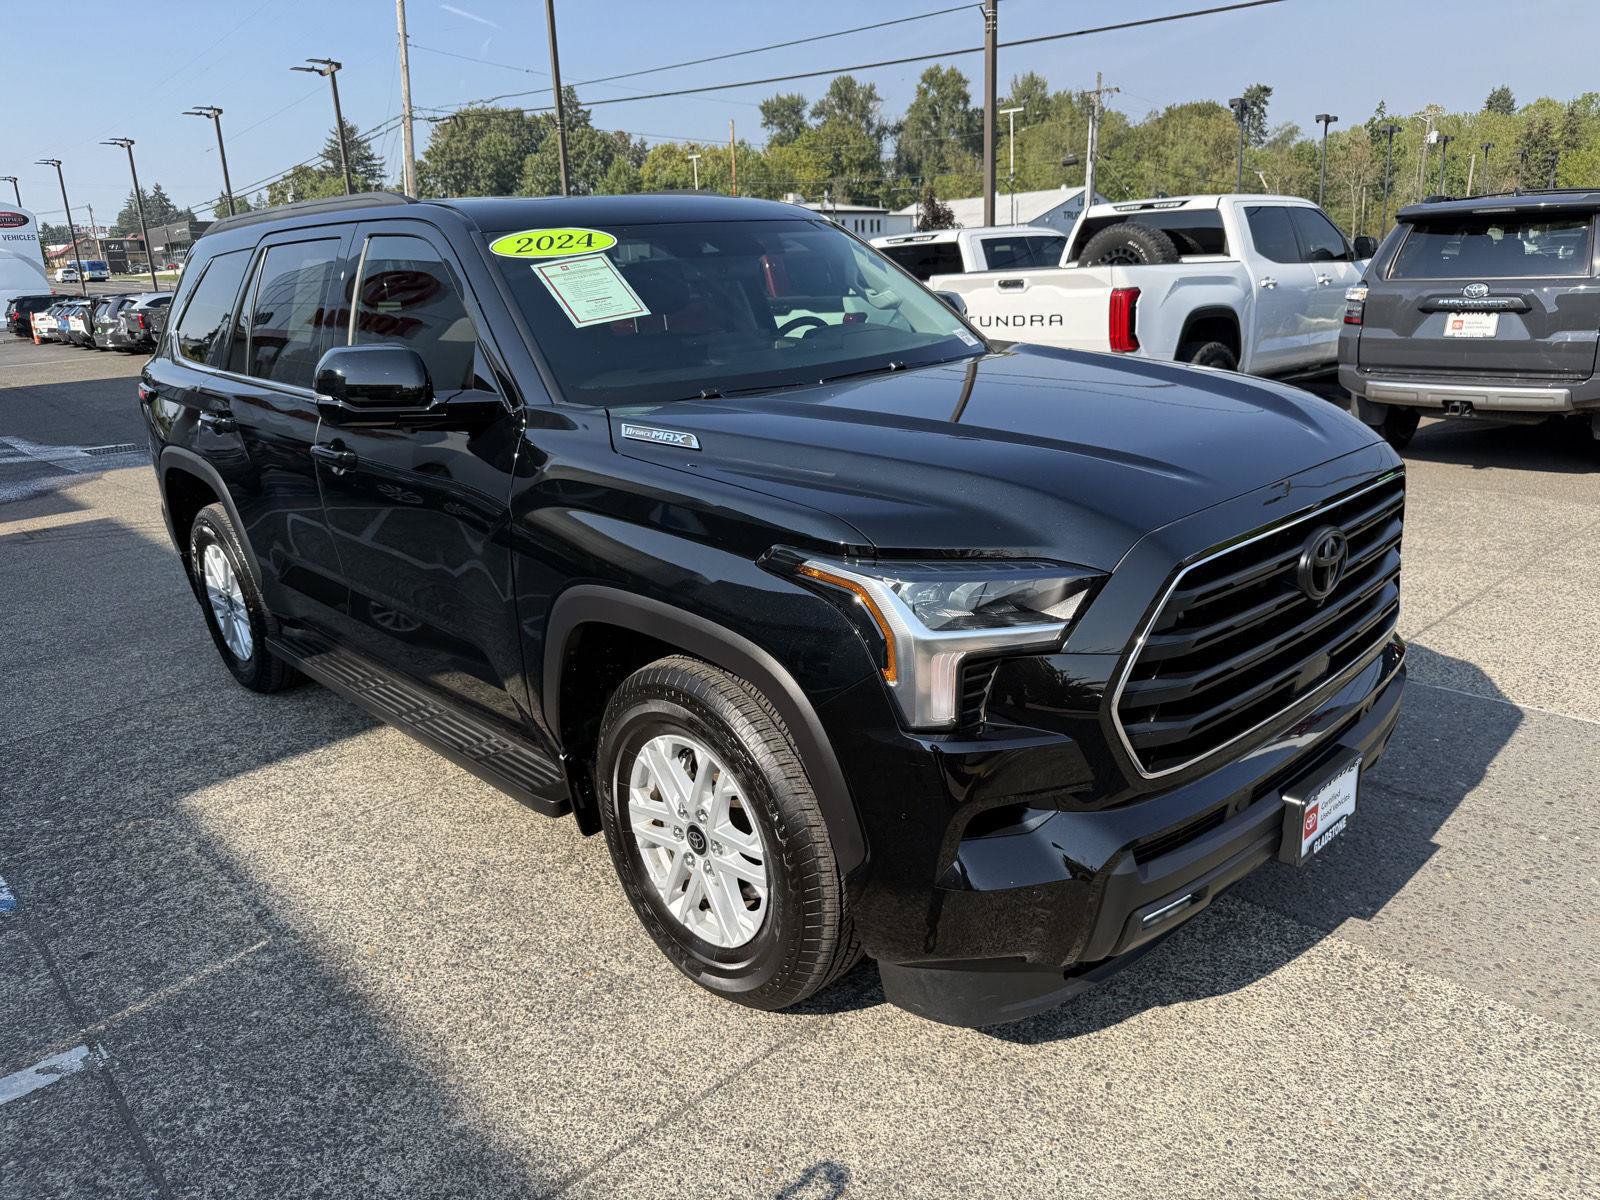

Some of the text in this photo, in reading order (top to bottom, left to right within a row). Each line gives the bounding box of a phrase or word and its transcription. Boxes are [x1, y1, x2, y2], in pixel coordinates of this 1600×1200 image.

[515, 233, 597, 253] 2024
[651, 430, 687, 444] MAX
[1313, 815, 1348, 854] GLADSTONE
